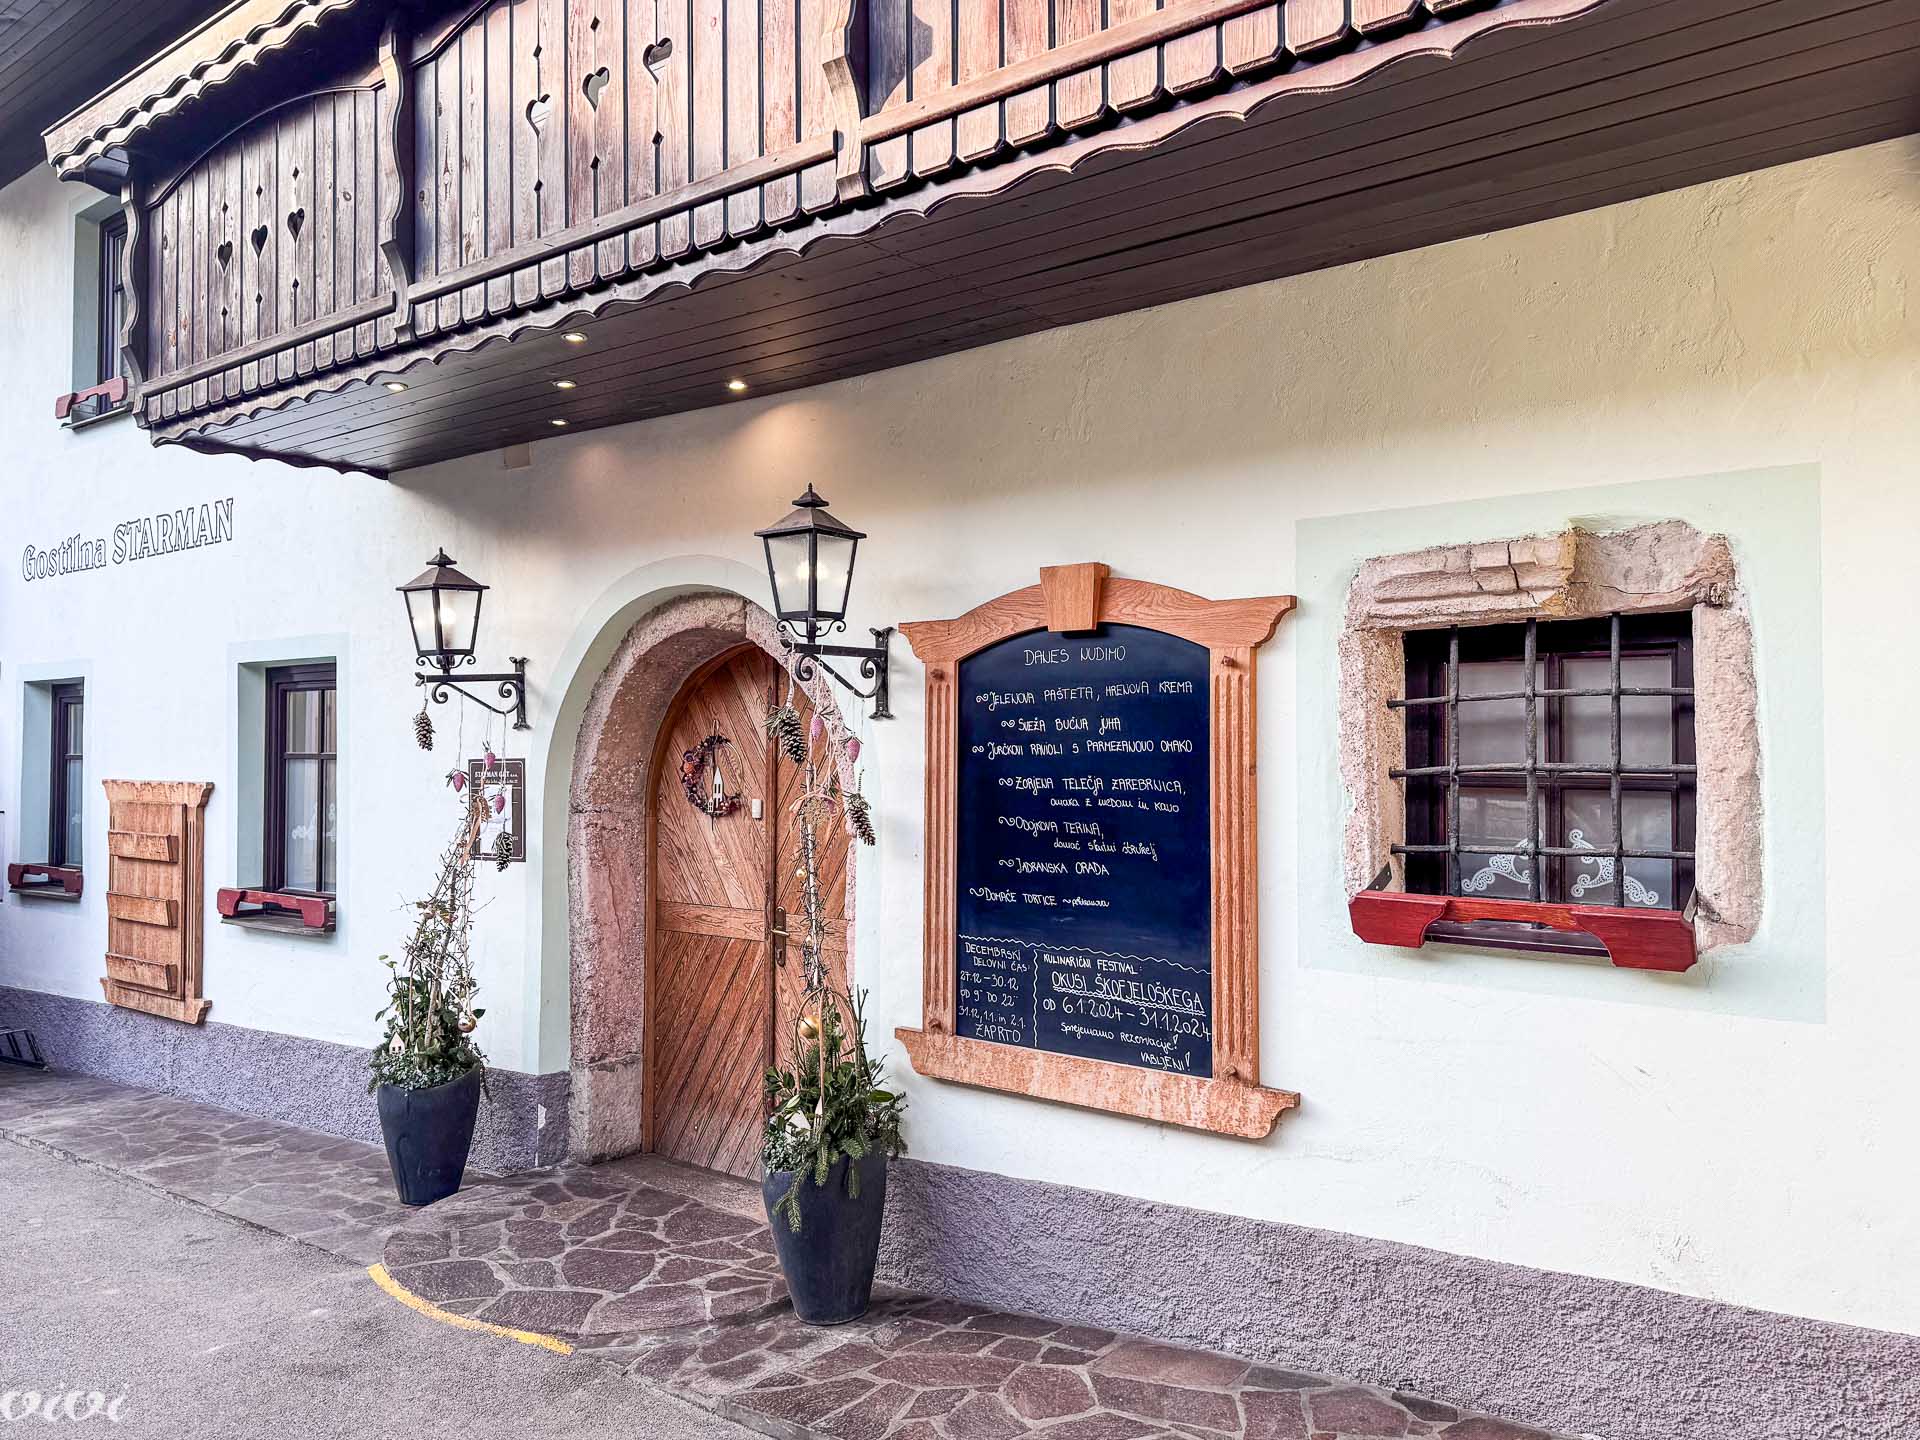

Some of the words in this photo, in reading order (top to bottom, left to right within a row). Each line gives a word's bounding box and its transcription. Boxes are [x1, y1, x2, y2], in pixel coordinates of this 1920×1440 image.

[22, 533, 107, 582] Gostilna
[112, 497, 234, 565] STARMAN
[1024, 649, 1070, 666] DANES
[1080, 646, 1127, 662] NUDIMO
[988, 691, 1035, 712] JELENOVA
[1043, 687, 1101, 702] PAŠTETA,
[1105, 680, 1150, 697] HRENOVA
[1158, 680, 1193, 693] KREMA
[1017, 717, 1046, 732] SVEŽA
[1055, 716, 1089, 731] BUČNA
[987, 741, 1024, 760] JURČKOVI
[1071, 743, 1079, 754] S
[1086, 740, 1154, 753] PARMEZANOVO
[1160, 740, 1193, 753] OMAKO
[1061, 775, 1104, 796] TELEČJA
[1111, 778, 1187, 796] ZAREBRNICA,
[1137, 797, 1150, 810] in
[1063, 821, 1105, 840] TERINA,
[1053, 838, 1081, 851] domač
[1015, 857, 1068, 874] JADRANSKA
[1075, 861, 1110, 876] ORADA
[983, 886, 1017, 903] DOMAČE
[1021, 893, 1057, 907] TORTICE
[965, 942, 1021, 961] DECEMBRSKI
[973, 955, 1007, 970] DELOVNI
[1043, 953, 1092, 969] KULINARIČNI
[1097, 959, 1143, 975] FESTIVAL:
[960, 988, 971, 999] OD
[986, 991, 998, 1003] DO
[1051, 971, 1088, 992] OKUSI
[1094, 973, 1205, 1012] ŠKOFJELOŠKEGA
[998, 1013, 1007, 1025] in
[1043, 998, 1056, 1011] OD
[1062, 996, 1123, 1022] 6.1.2024
[1138, 1007, 1212, 1042] 31.1.2024
[975, 1023, 1021, 1043] ZAPRTO
[1060, 1022, 1114, 1039] Sprejemamo
[1140, 1051, 1191, 1072] VABLJENI!
